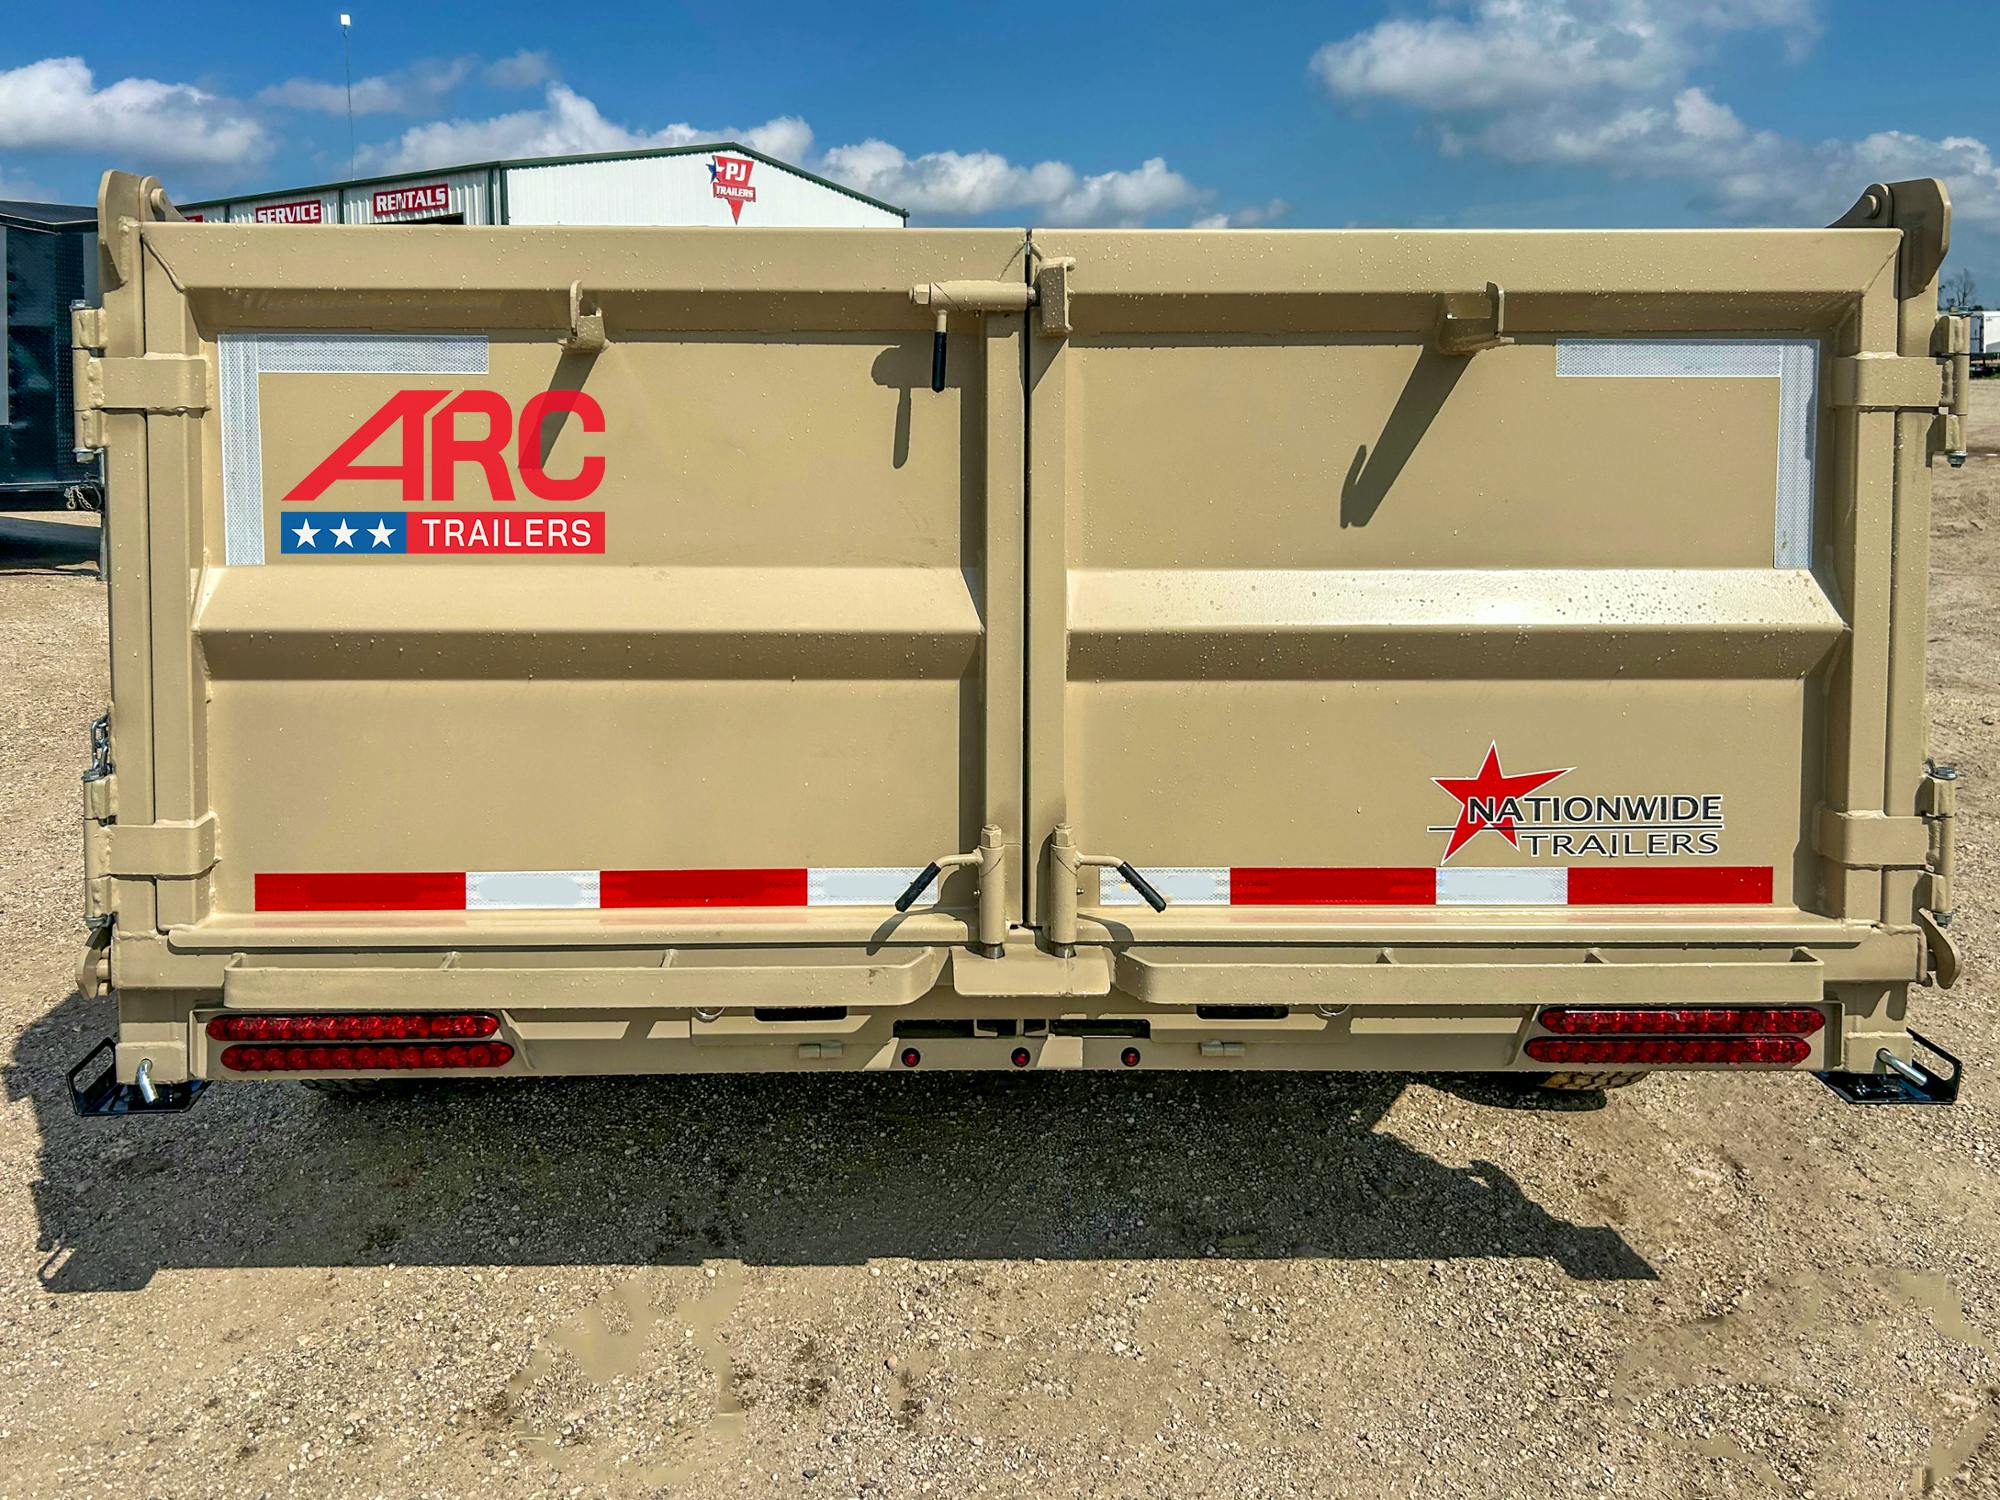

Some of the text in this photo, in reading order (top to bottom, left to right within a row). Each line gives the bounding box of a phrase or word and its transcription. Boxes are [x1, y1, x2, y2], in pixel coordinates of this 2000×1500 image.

[725, 162, 747, 182] PJ
[376, 187, 446, 212] RENTALS
[716, 185, 754, 199] TRAILERS
[257, 203, 320, 224] SERVICE
[281, 390, 606, 501] ARC
[421, 518, 592, 548] TRAILERS
[1467, 794, 1724, 824] NATIONWIDE
[1519, 832, 1721, 857] TRAILERS
